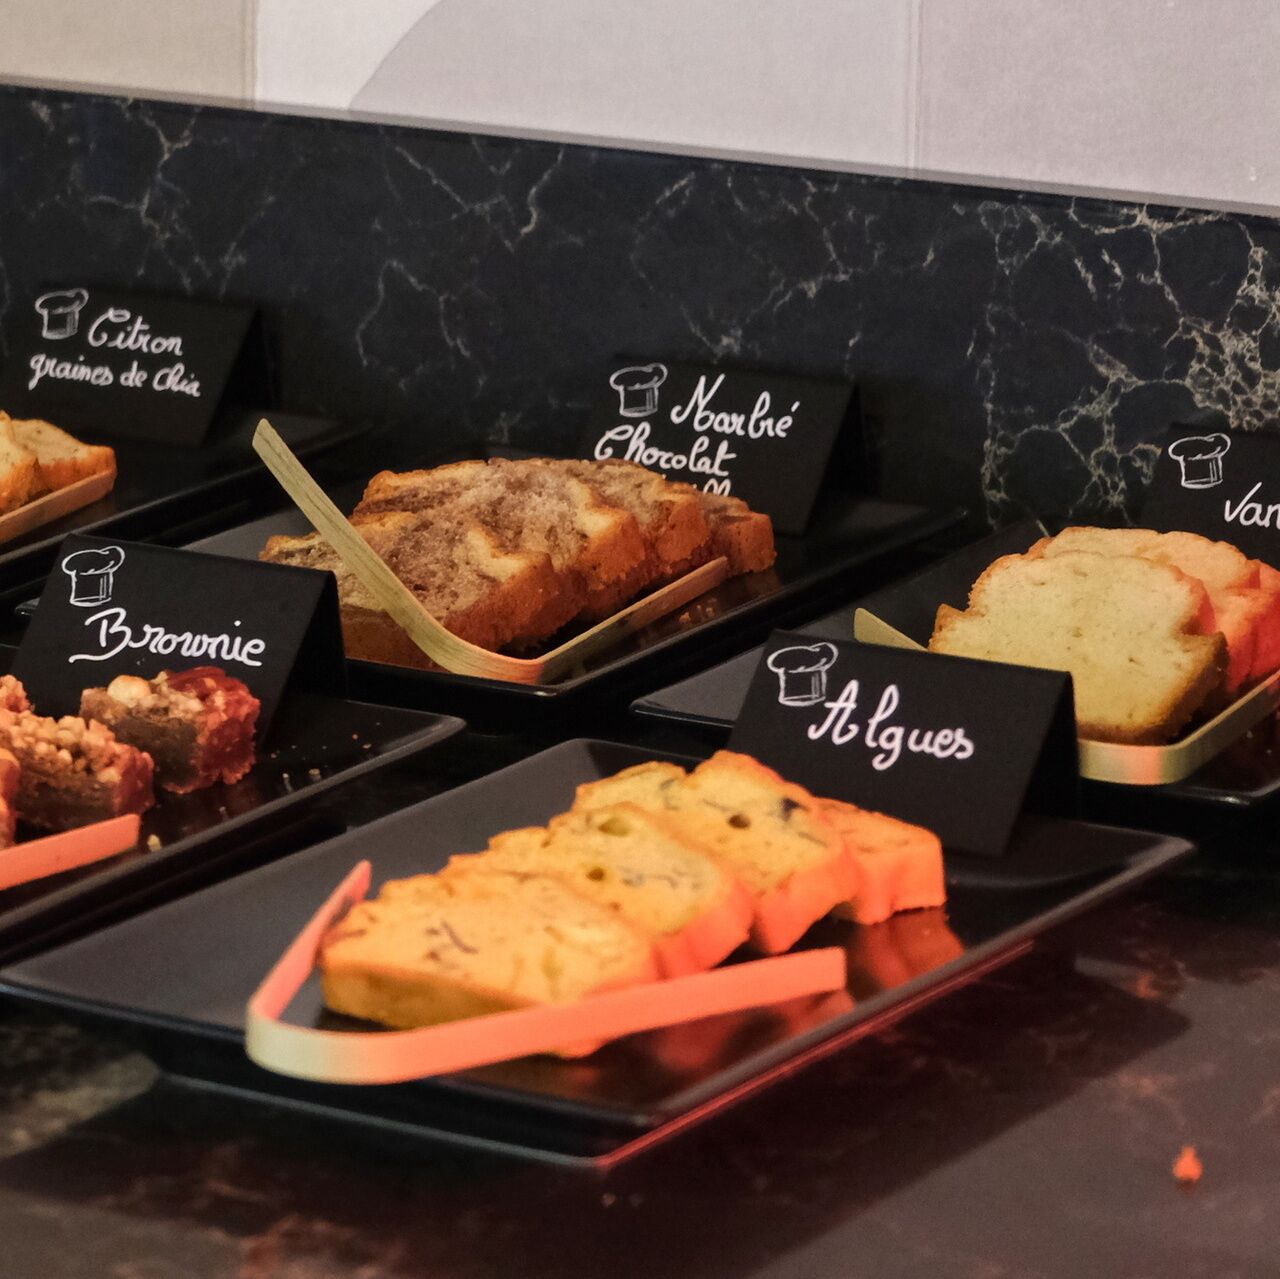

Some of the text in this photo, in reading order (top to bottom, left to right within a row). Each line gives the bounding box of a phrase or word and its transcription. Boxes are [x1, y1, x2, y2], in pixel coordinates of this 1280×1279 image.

[88, 307, 183, 357] Citron
[28, 353, 114, 391] graines
[119, 360, 148, 388] de
[594, 421, 738, 477] Chocolat
[68, 607, 266, 667] Brownie
[807, 679, 975, 771] Algues
